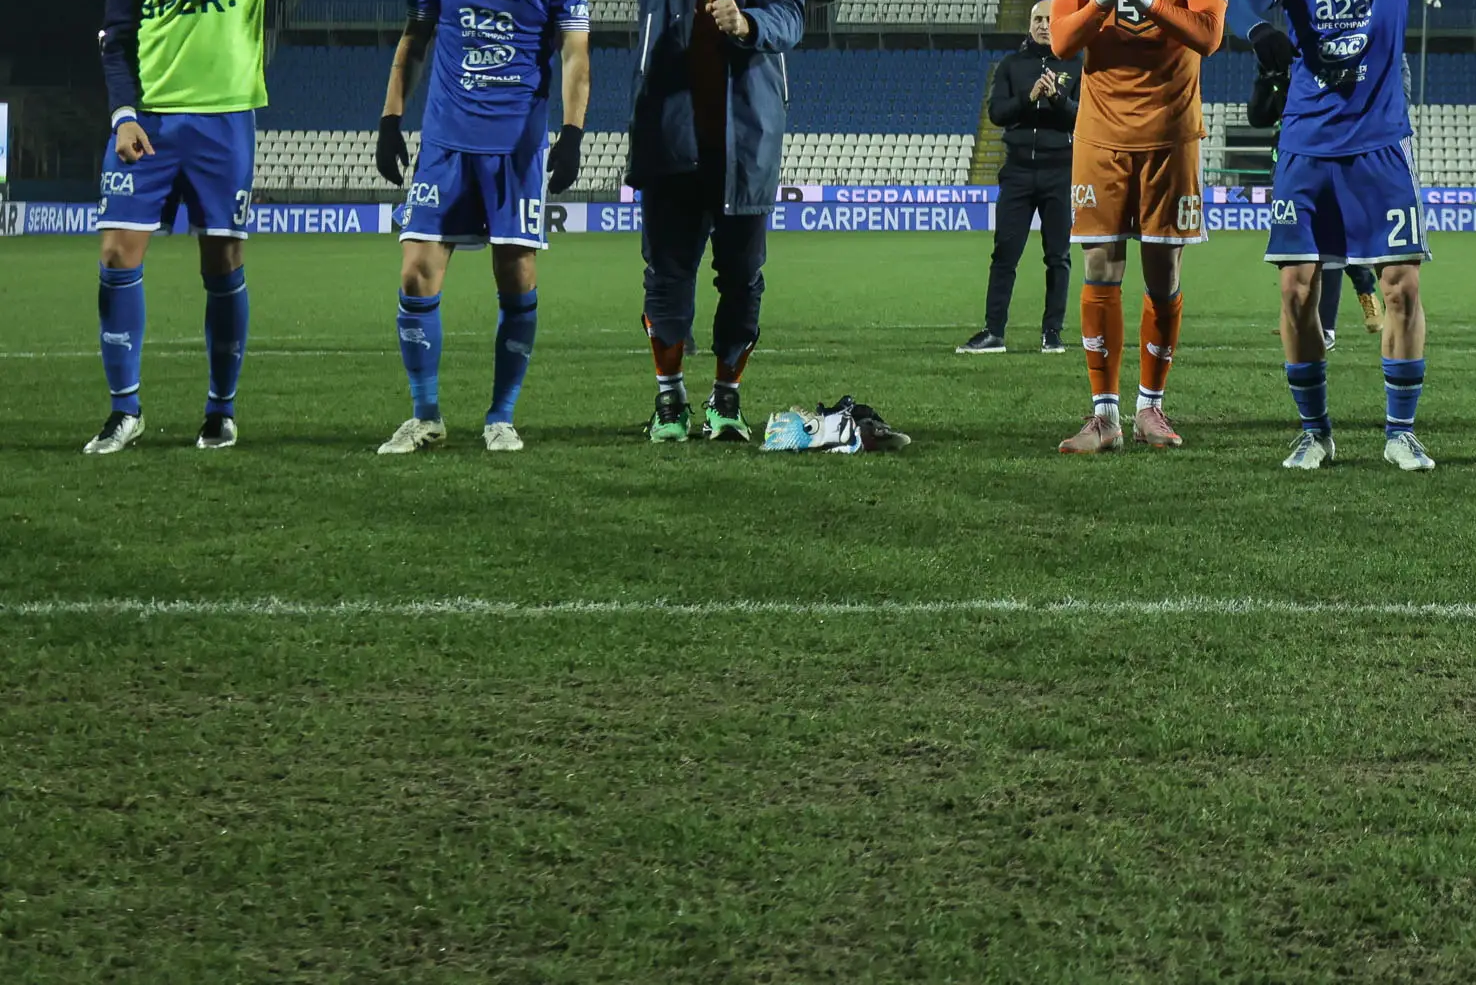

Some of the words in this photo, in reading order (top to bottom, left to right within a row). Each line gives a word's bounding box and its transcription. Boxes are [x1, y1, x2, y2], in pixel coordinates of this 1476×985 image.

[459, 7, 514, 33] a2a
[1317, 22, 1333, 30] LIFE
[461, 30, 476, 38] LIFE
[468, 50, 507, 65] DAC
[1321, 40, 1361, 56] DAC
[519, 199, 541, 235] 15
[801, 206, 972, 231] CARPENTERIA
[1386, 206, 1419, 248] 21
